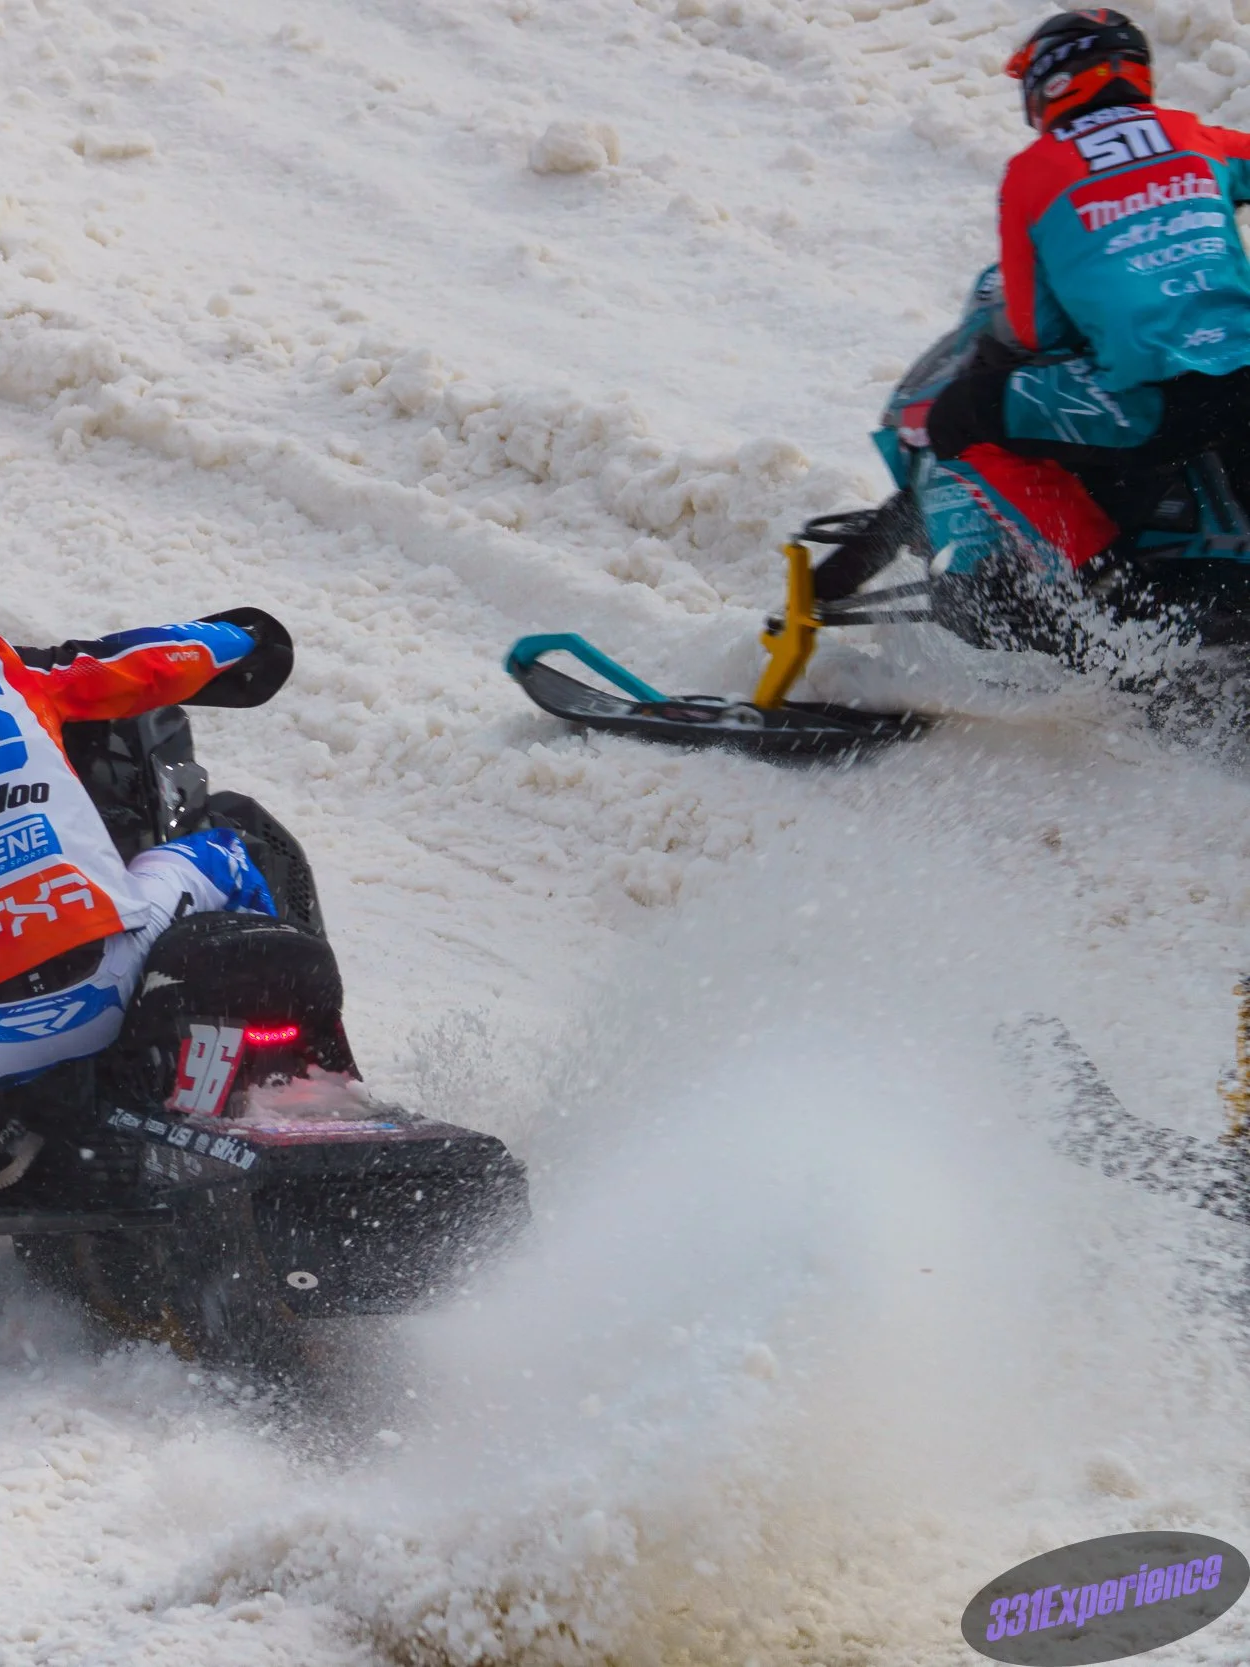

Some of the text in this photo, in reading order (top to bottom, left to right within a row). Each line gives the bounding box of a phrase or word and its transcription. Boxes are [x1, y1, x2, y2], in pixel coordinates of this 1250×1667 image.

[1075, 172, 1223, 231] makita
[10, 846, 49, 868] SPORTS
[173, 1023, 244, 1114] 96
